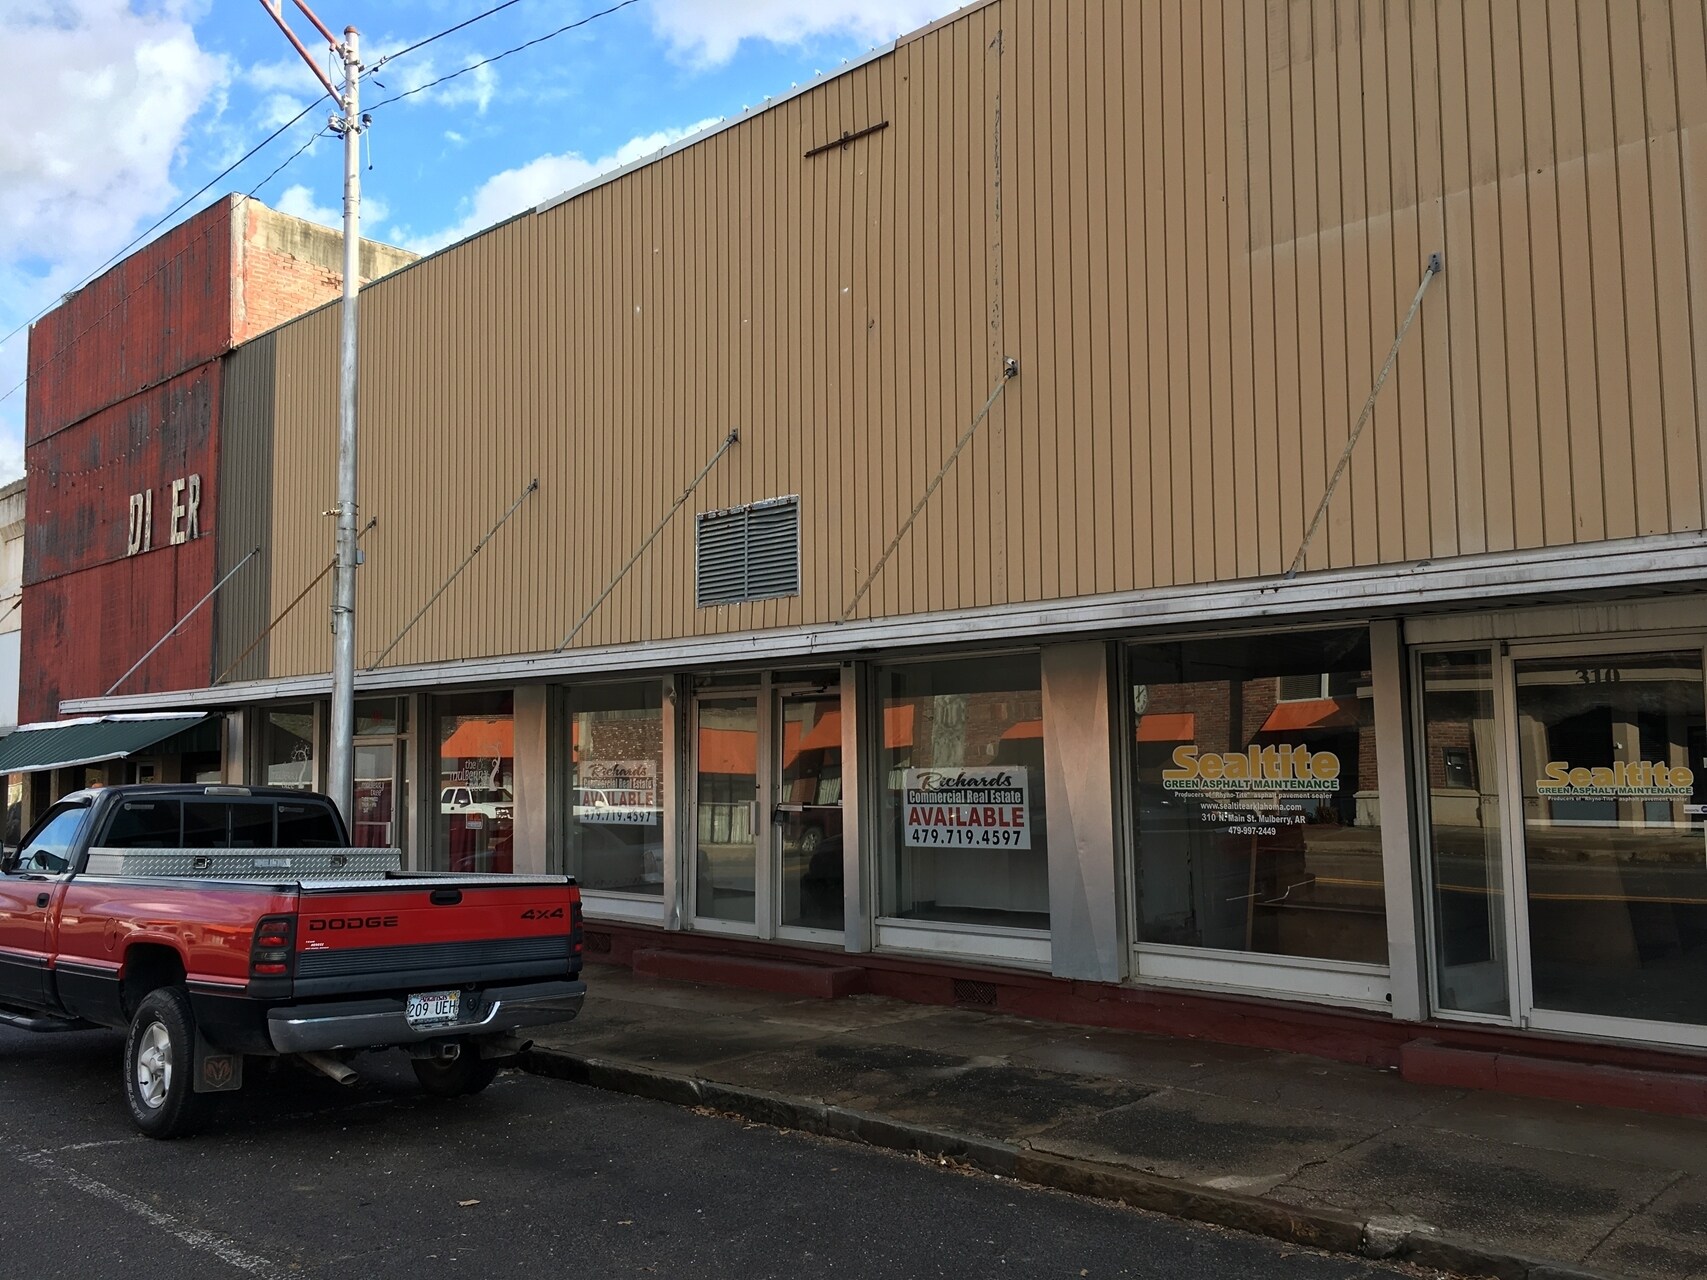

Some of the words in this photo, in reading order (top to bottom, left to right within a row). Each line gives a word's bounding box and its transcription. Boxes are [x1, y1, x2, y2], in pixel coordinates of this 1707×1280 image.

[1575, 669, 1620, 684] 310
[1162, 744, 1340, 780] Sealtite
[588, 764, 647, 778] Richards
[1536, 761, 1694, 787] Sealtite
[916, 771, 1013, 791] Richards
[1164, 779, 1200, 789] GREEN
[1202, 779, 1250, 789] ASPHALT
[1253, 779, 1338, 789] MAINTENANCE
[583, 791, 653, 806] AVAILABLE
[909, 790, 965, 804] Commercial
[966, 790, 988, 803] Real
[990, 790, 1021, 803] Estate
[1174, 791, 1204, 799] Producers
[1253, 792, 1277, 800] asphalt
[1200, 802, 1302, 811] www.sealtitearklahoma.com
[584, 809, 651, 822] 479.719.4597
[908, 806, 1025, 827] AVAILABLE
[1201, 813, 1216, 822] 310
[1218, 813, 1227, 822] N.
[1228, 814, 1245, 823] Main
[1246, 814, 1257, 823] St.
[1258, 815, 1293, 825] Mulberry,
[1294, 815, 1306, 824] AR
[912, 829, 1021, 845] 479.719.4597
[1228, 826, 1277, 836] 479-997-2449
[309, 916, 399, 931] DODGE
[409, 1002, 429, 1018] 209
[435, 1000, 456, 1015] UEH
